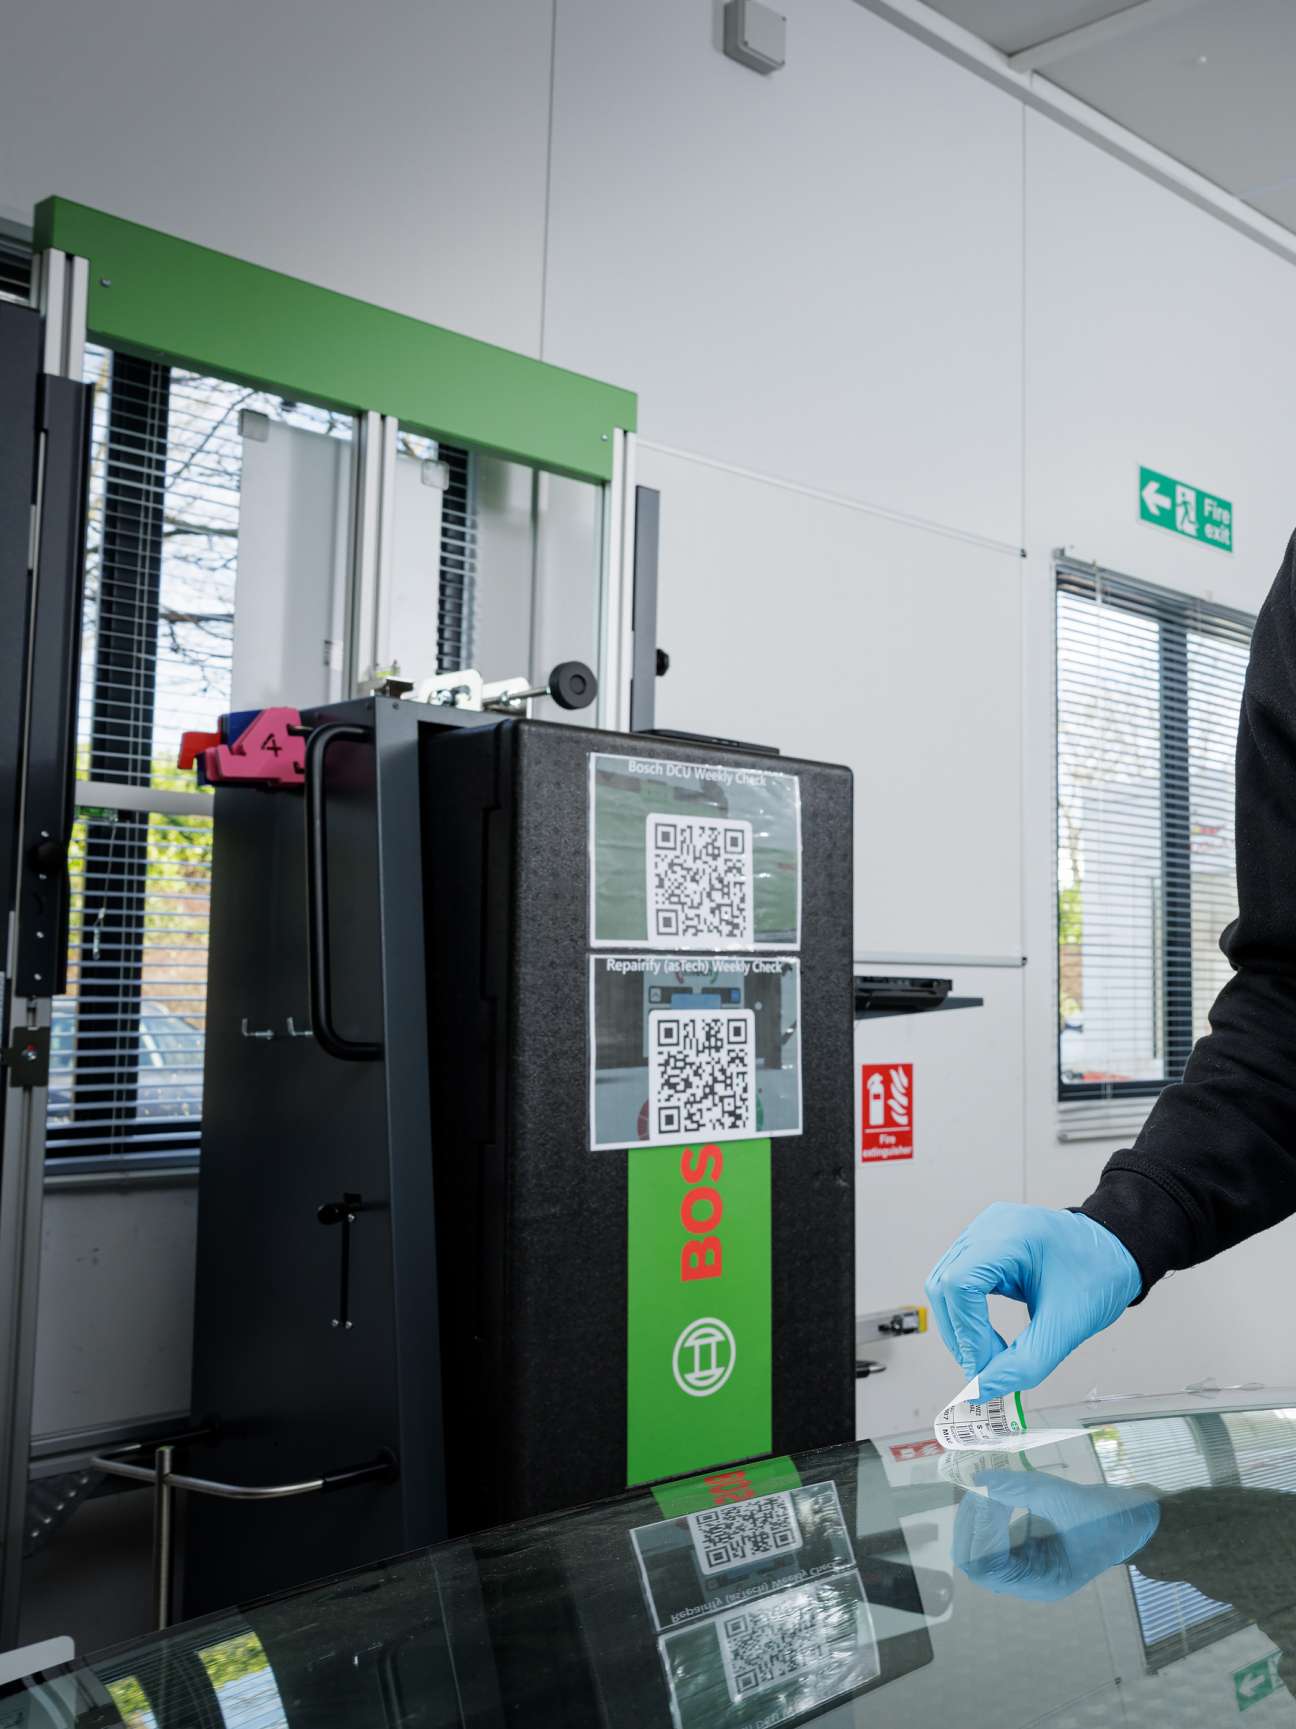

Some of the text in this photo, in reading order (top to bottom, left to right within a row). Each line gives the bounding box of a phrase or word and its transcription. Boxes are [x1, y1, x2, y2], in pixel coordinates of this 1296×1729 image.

[1203, 497, 1231, 525] Fire
[1203, 522, 1231, 546] exit
[261, 733, 283, 757] 4
[628, 760, 767, 787] Bosch DCU Weekly Check
[606, 958, 661, 975] Repairify
[711, 960, 750, 976] Weekly
[752, 961, 782, 973] Check
[680, 1144, 724, 1282] BOS
